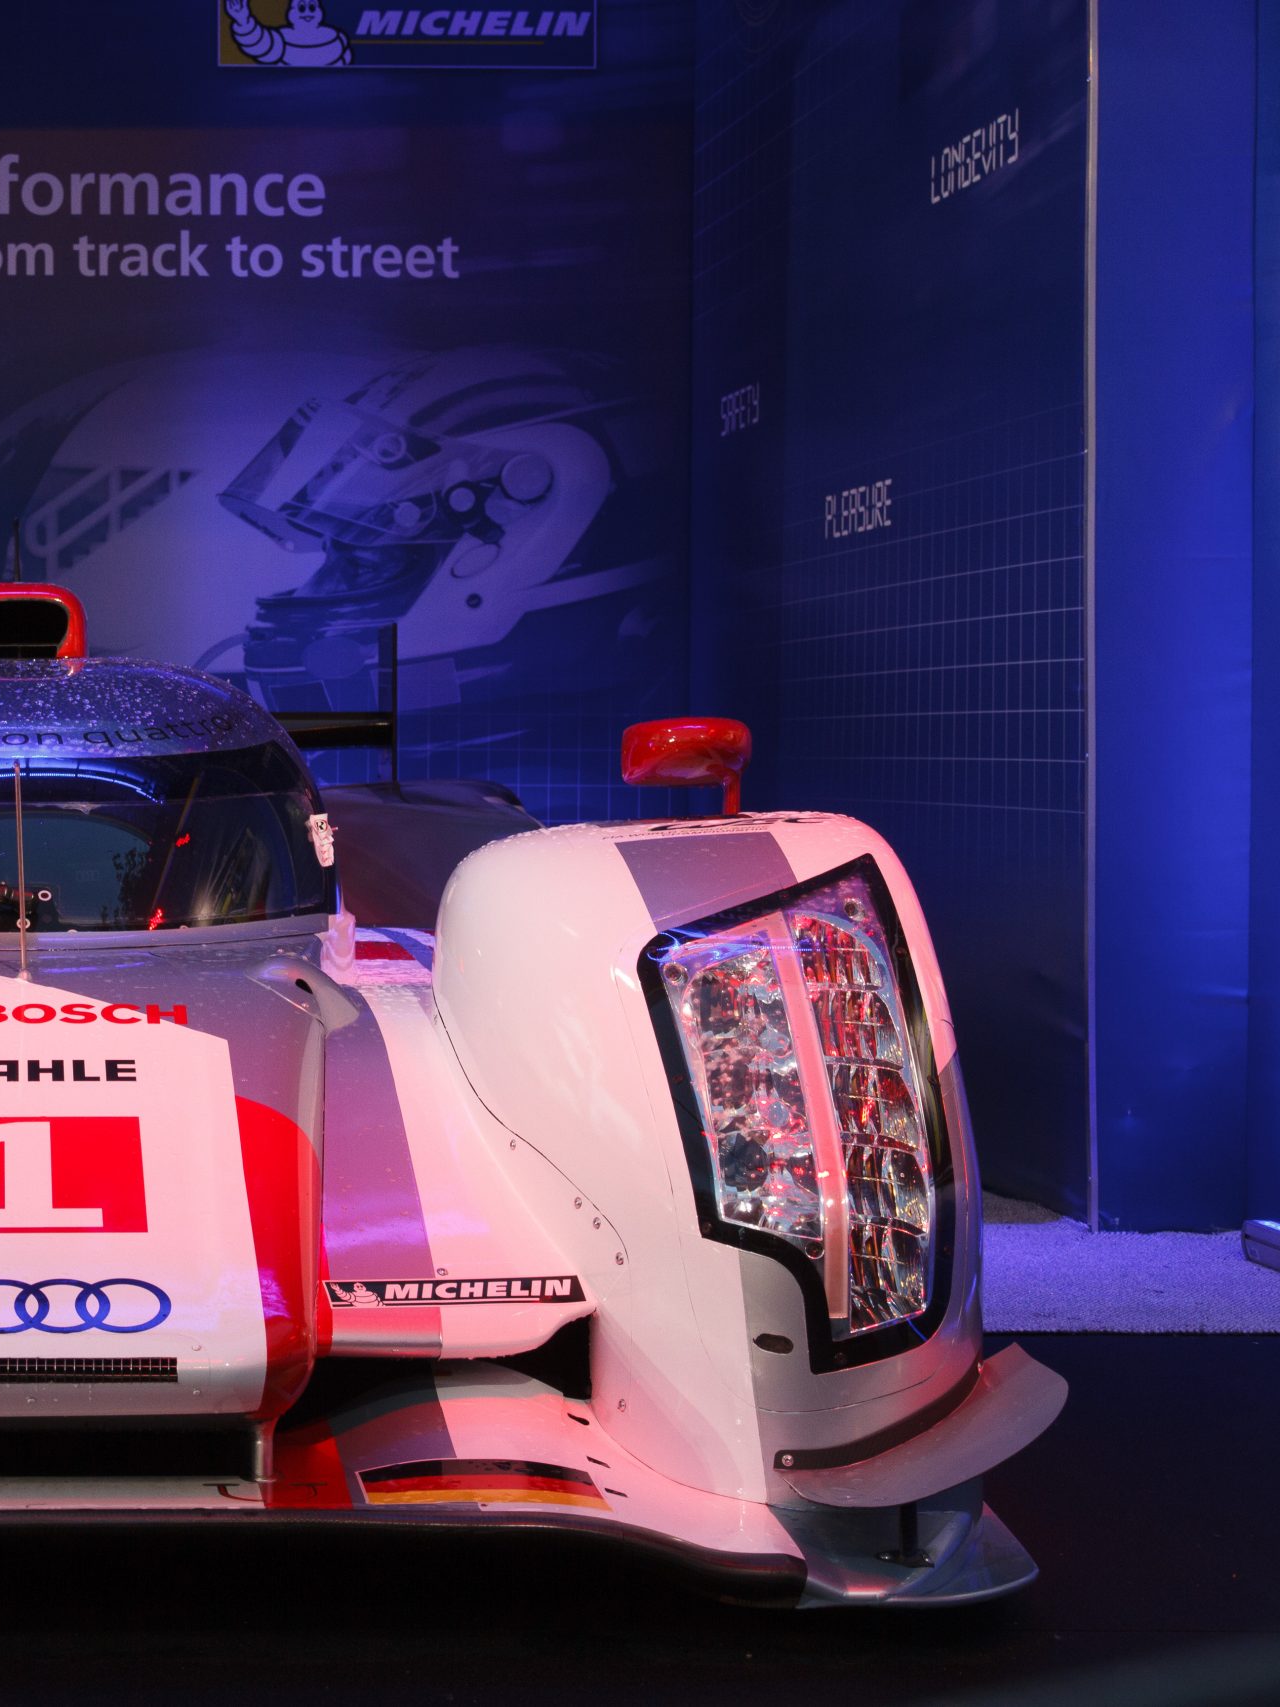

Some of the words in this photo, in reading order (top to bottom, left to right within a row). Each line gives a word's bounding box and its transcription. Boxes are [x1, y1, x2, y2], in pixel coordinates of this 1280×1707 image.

[356, 10, 591, 37] MICHELIN
[931, 107, 1019, 204] LONGEVITY
[74, 230, 209, 278] track
[226, 235, 283, 279] to
[300, 235, 459, 279] street
[720, 380, 760, 437] SAFETY
[825, 478, 892, 540] PLEASURE
[83, 716, 232, 747] quattro
[384, 1278, 571, 1300] MICHELIN
